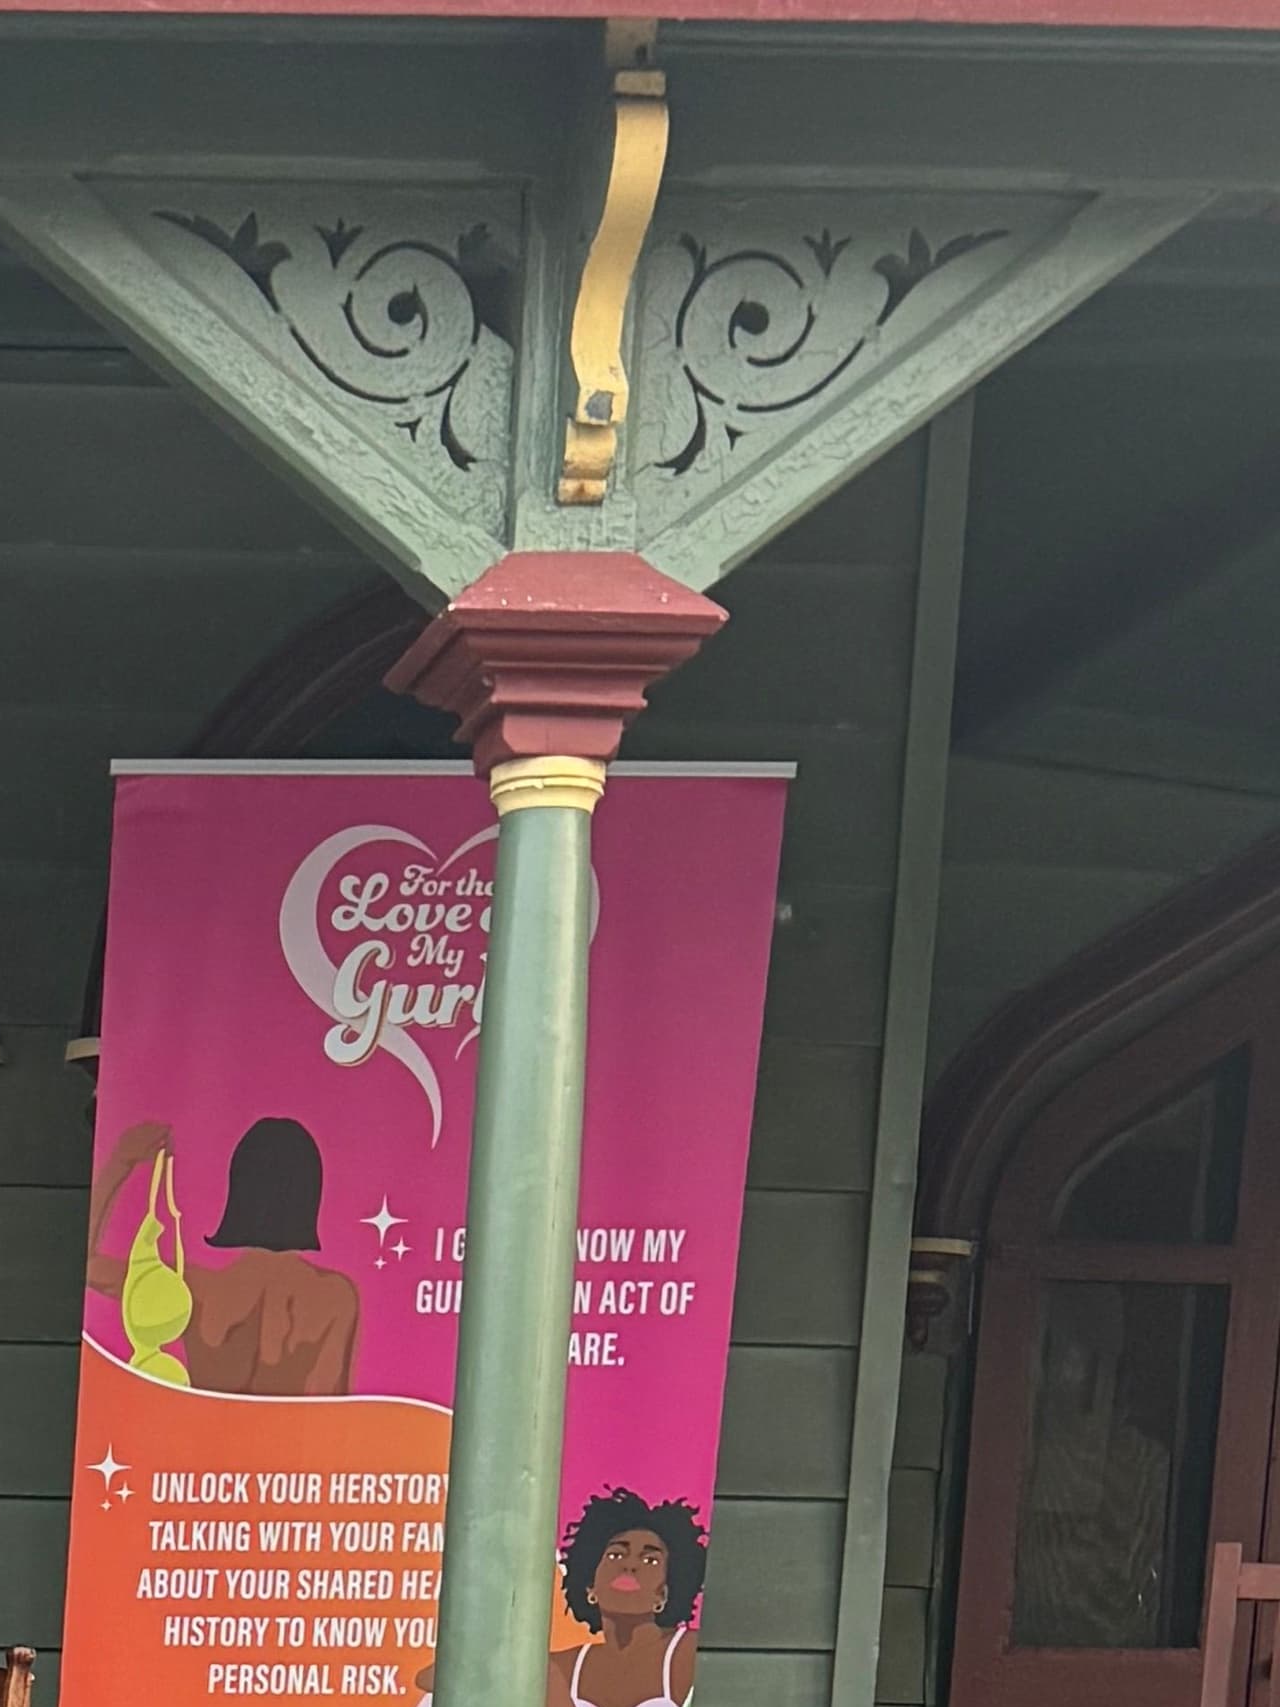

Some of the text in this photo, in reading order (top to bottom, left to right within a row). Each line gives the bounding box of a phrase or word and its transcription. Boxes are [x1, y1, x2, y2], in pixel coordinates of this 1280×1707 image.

[399, 864, 452, 896] For
[331, 872, 472, 933] Love
[406, 933, 464, 978] My
[434, 1227, 444, 1262] I
[642, 1228, 686, 1263] MY
[598, 1281, 696, 1315] ACT OF
[152, 1472, 251, 1504] UNLOCK
[256, 1473, 321, 1505] YOUR
[148, 1521, 395, 1553] TALKING WITH YOUR
[136, 1568, 219, 1600] ABOUT
[225, 1569, 291, 1600] YOUR
[296, 1570, 394, 1601] SHARED
[163, 1616, 269, 1647] HISTORY
[275, 1617, 306, 1647] TO
[312, 1617, 387, 1648] KNOW
[207, 1664, 407, 1696] PERSONAL RISK.
